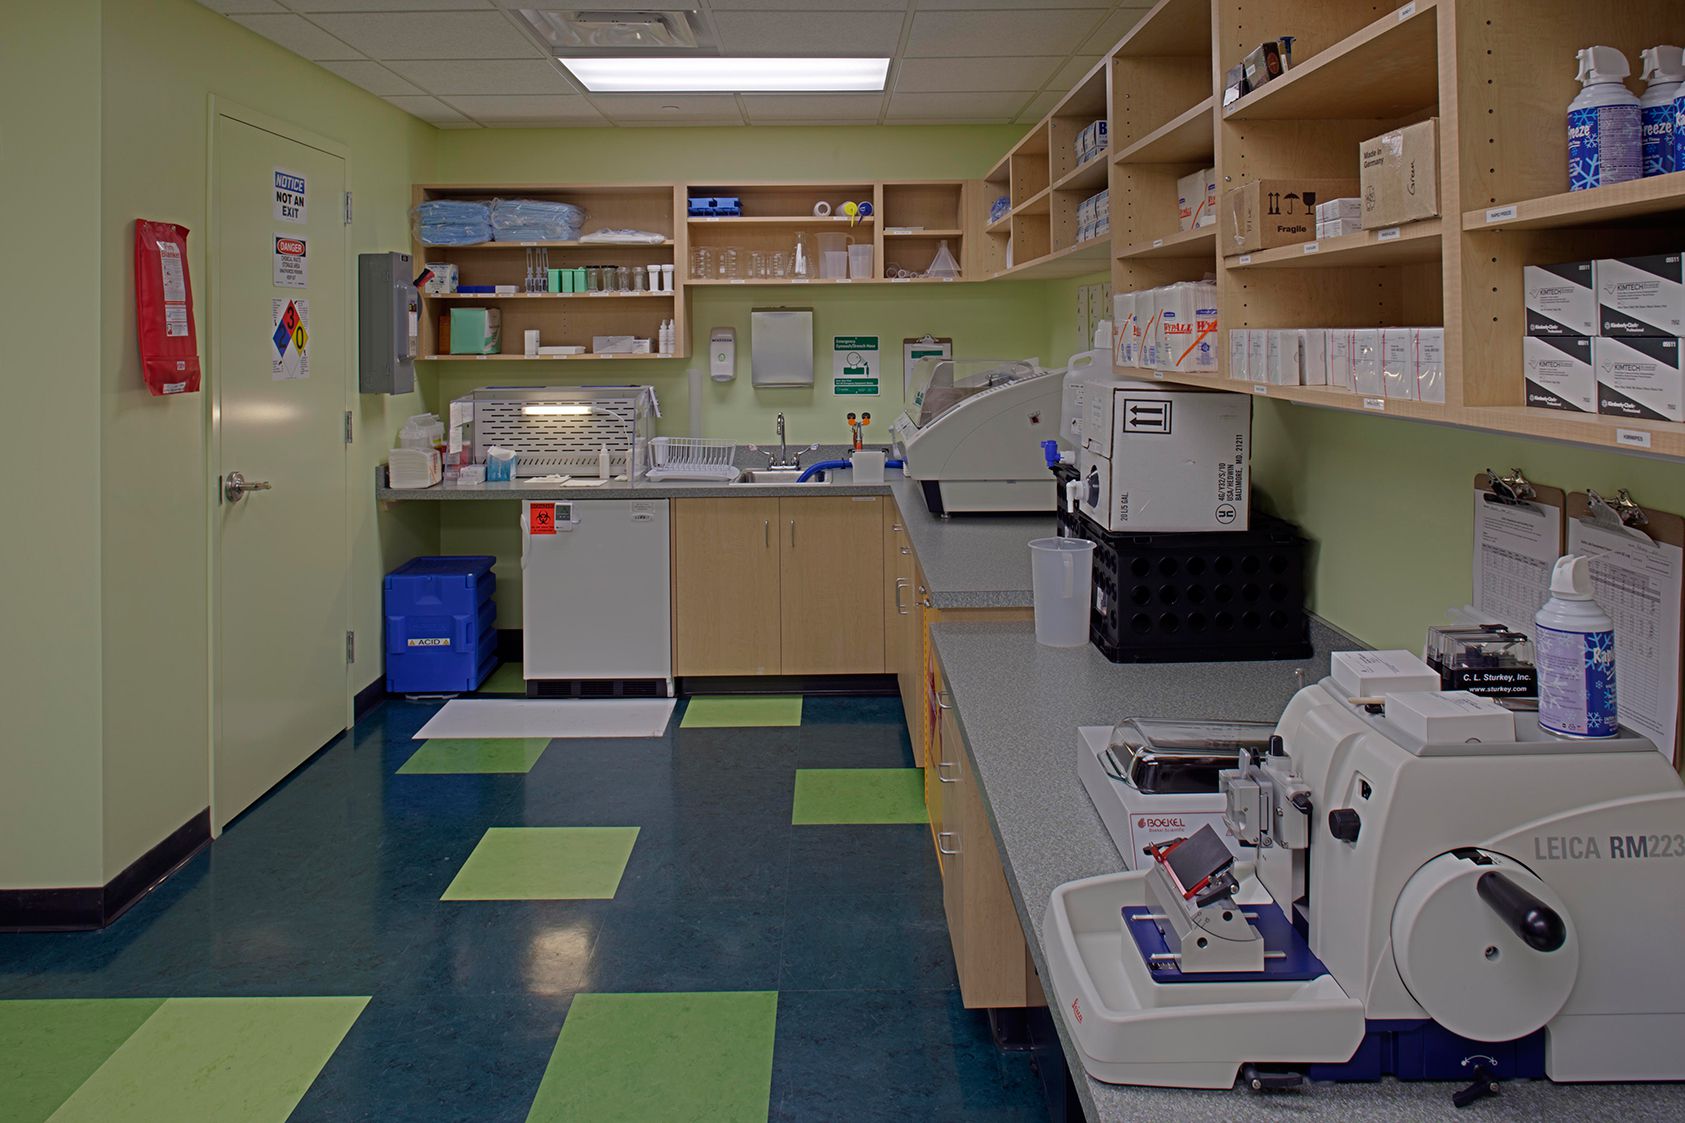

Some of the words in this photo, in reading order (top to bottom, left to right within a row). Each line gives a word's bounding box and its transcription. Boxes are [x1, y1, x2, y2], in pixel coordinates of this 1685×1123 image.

[1568, 124, 1591, 139] reeze
[1641, 121, 1673, 137] reeze
[1363, 150, 1377, 160] Made
[1363, 158, 1385, 169] Germany
[276, 173, 304, 192] NOTICE
[276, 191, 293, 205] NOT
[294, 195, 305, 208] AN
[282, 205, 299, 219] EXIT
[1277, 225, 1307, 234] Fragile
[280, 241, 302, 253] DANGER
[287, 305, 295, 330] 3
[278, 323, 288, 349] 2
[296, 325, 304, 350] 0
[1615, 363, 1641, 372] KIMTECH
[1235, 434, 1243, 452] 21211
[1226, 464, 1234, 501] USA/HEDWIN
[1463, 673, 1471, 682] C.
[1473, 673, 1481, 682] L.
[1483, 673, 1515, 683] Sturkey,
[1516, 673, 1532, 681] Inc.
[1146, 818, 1186, 828] BOEKEL
[1534, 836, 1602, 860] LEICA
[1609, 834, 1685, 859] RM223
